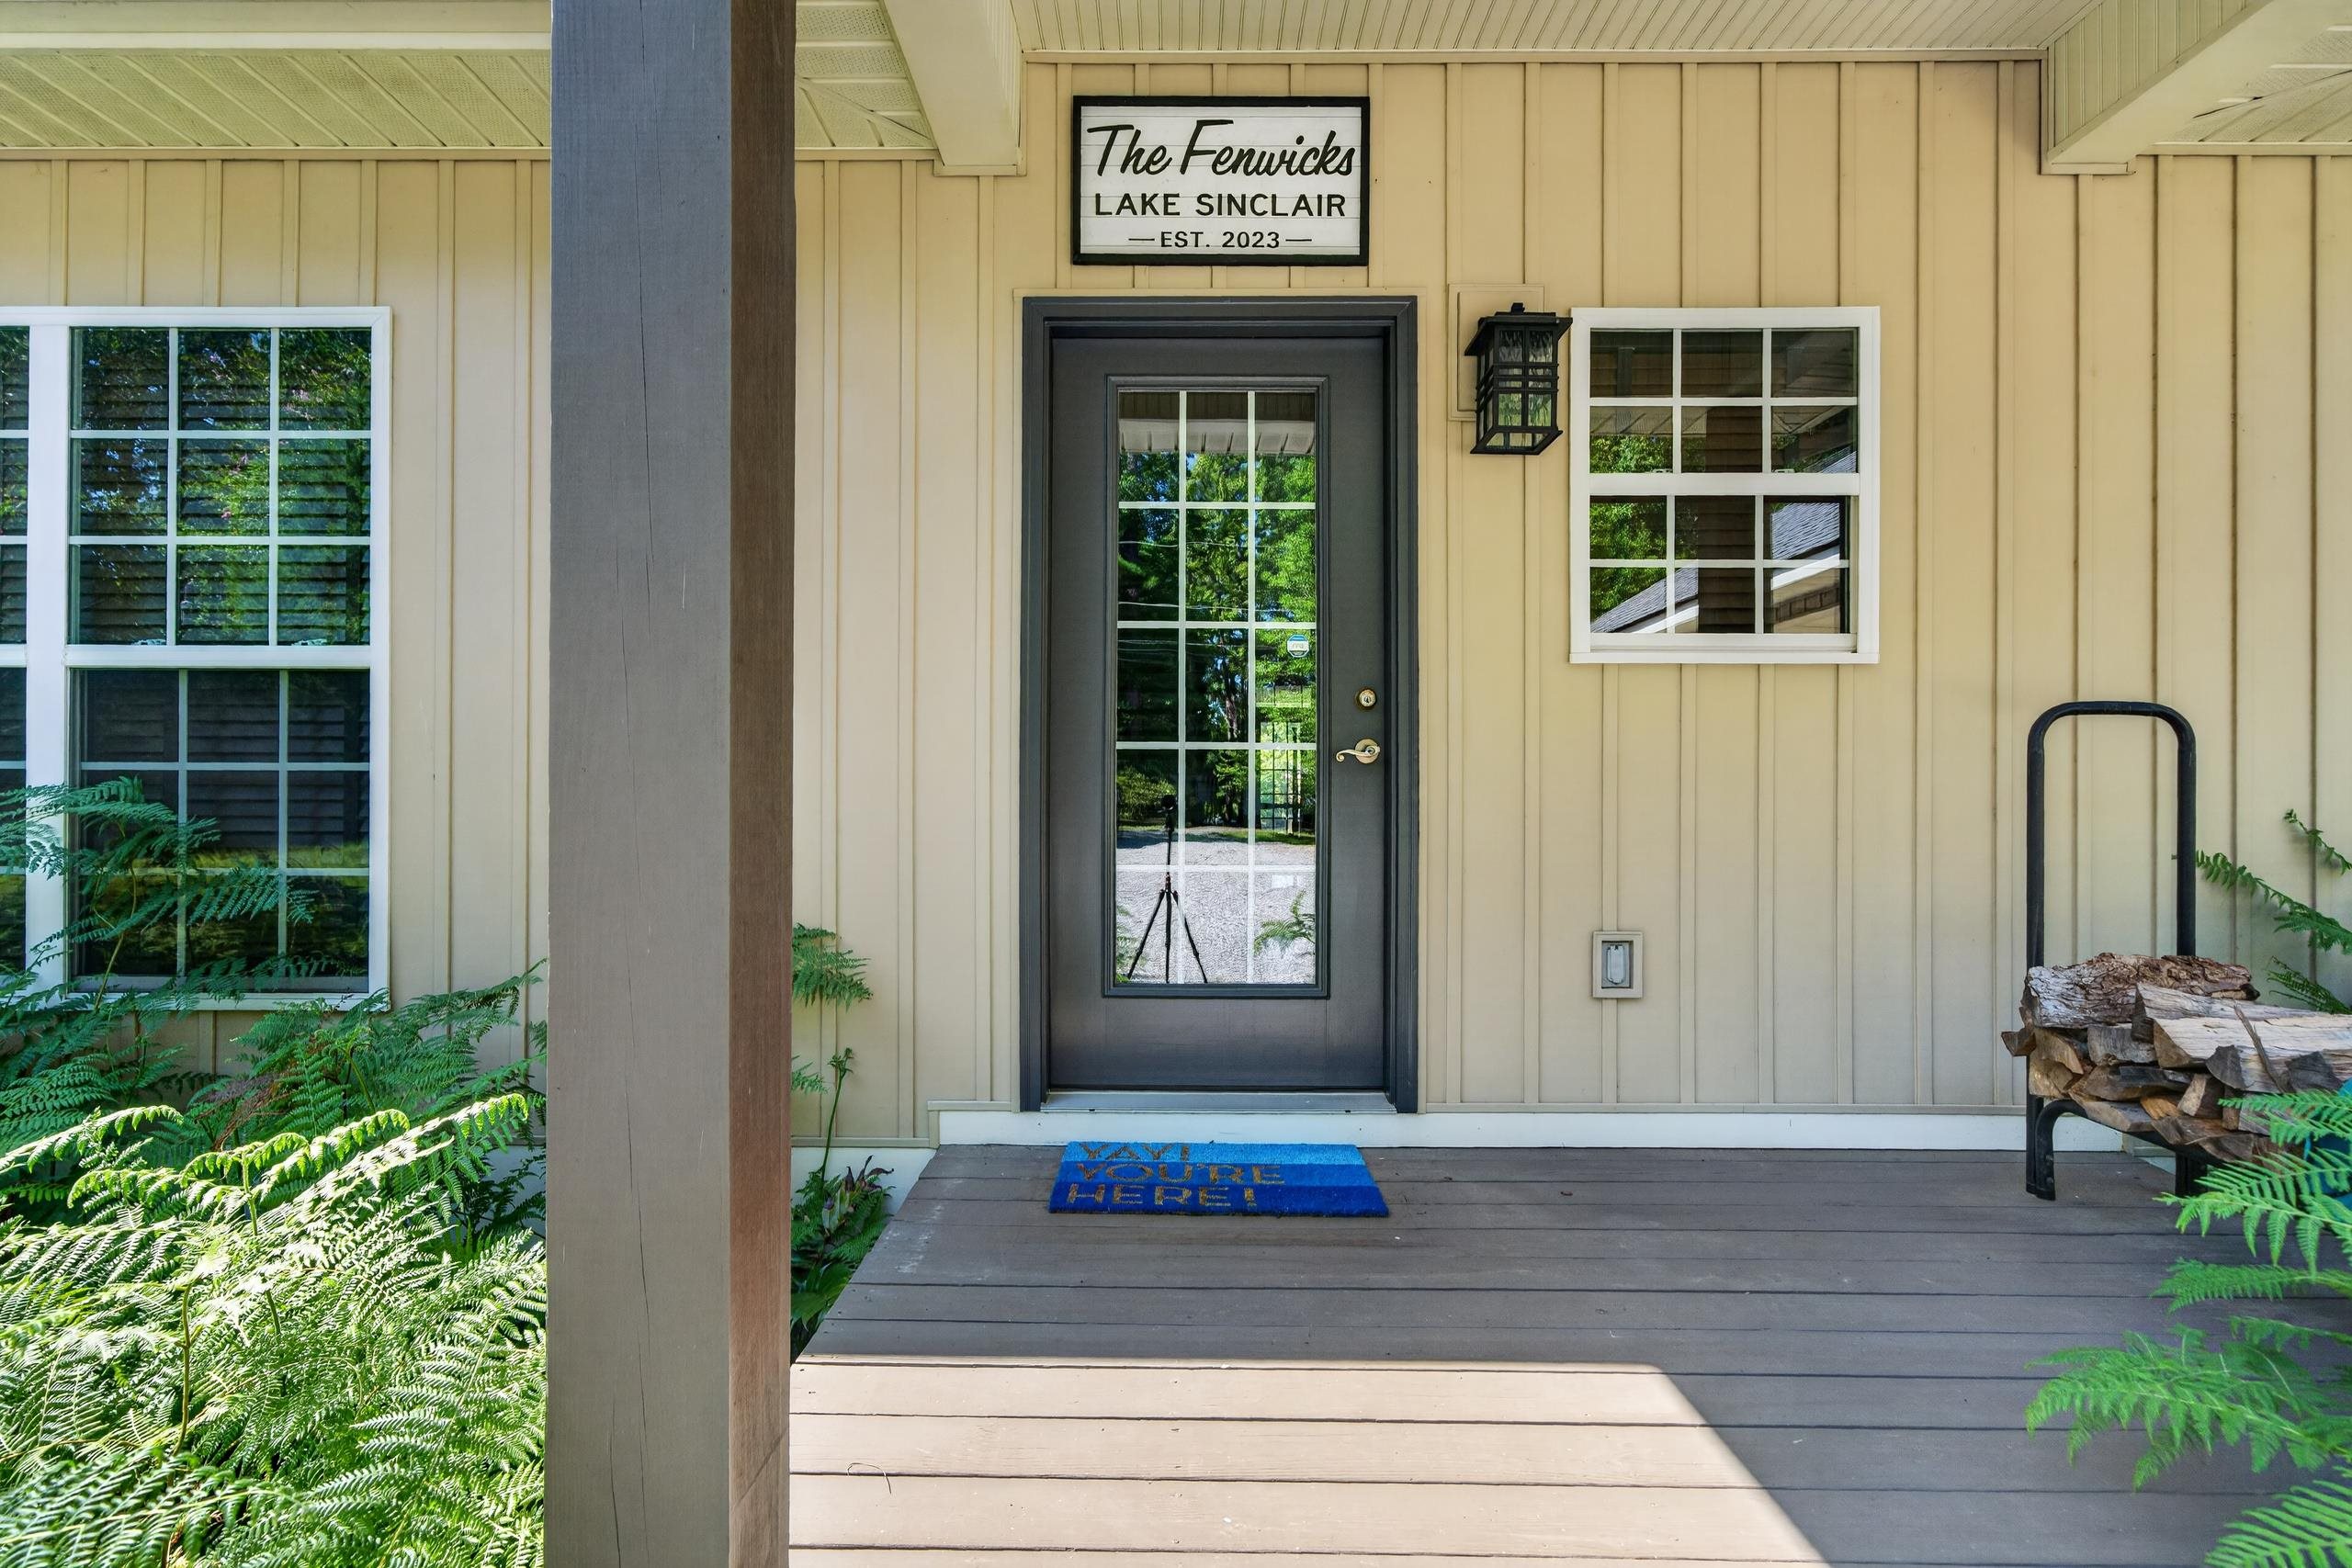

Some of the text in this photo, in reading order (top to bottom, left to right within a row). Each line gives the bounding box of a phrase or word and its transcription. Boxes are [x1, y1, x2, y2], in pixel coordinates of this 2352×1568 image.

[1086, 119, 1356, 176] The Fenwicks
[1094, 193, 1346, 217] LAKE SINCLAIR
[1160, 231, 1280, 249] EST. 2023
[1077, 1163, 1286, 1185] YOU'RE
[1068, 1183, 1257, 1207] HERE!
